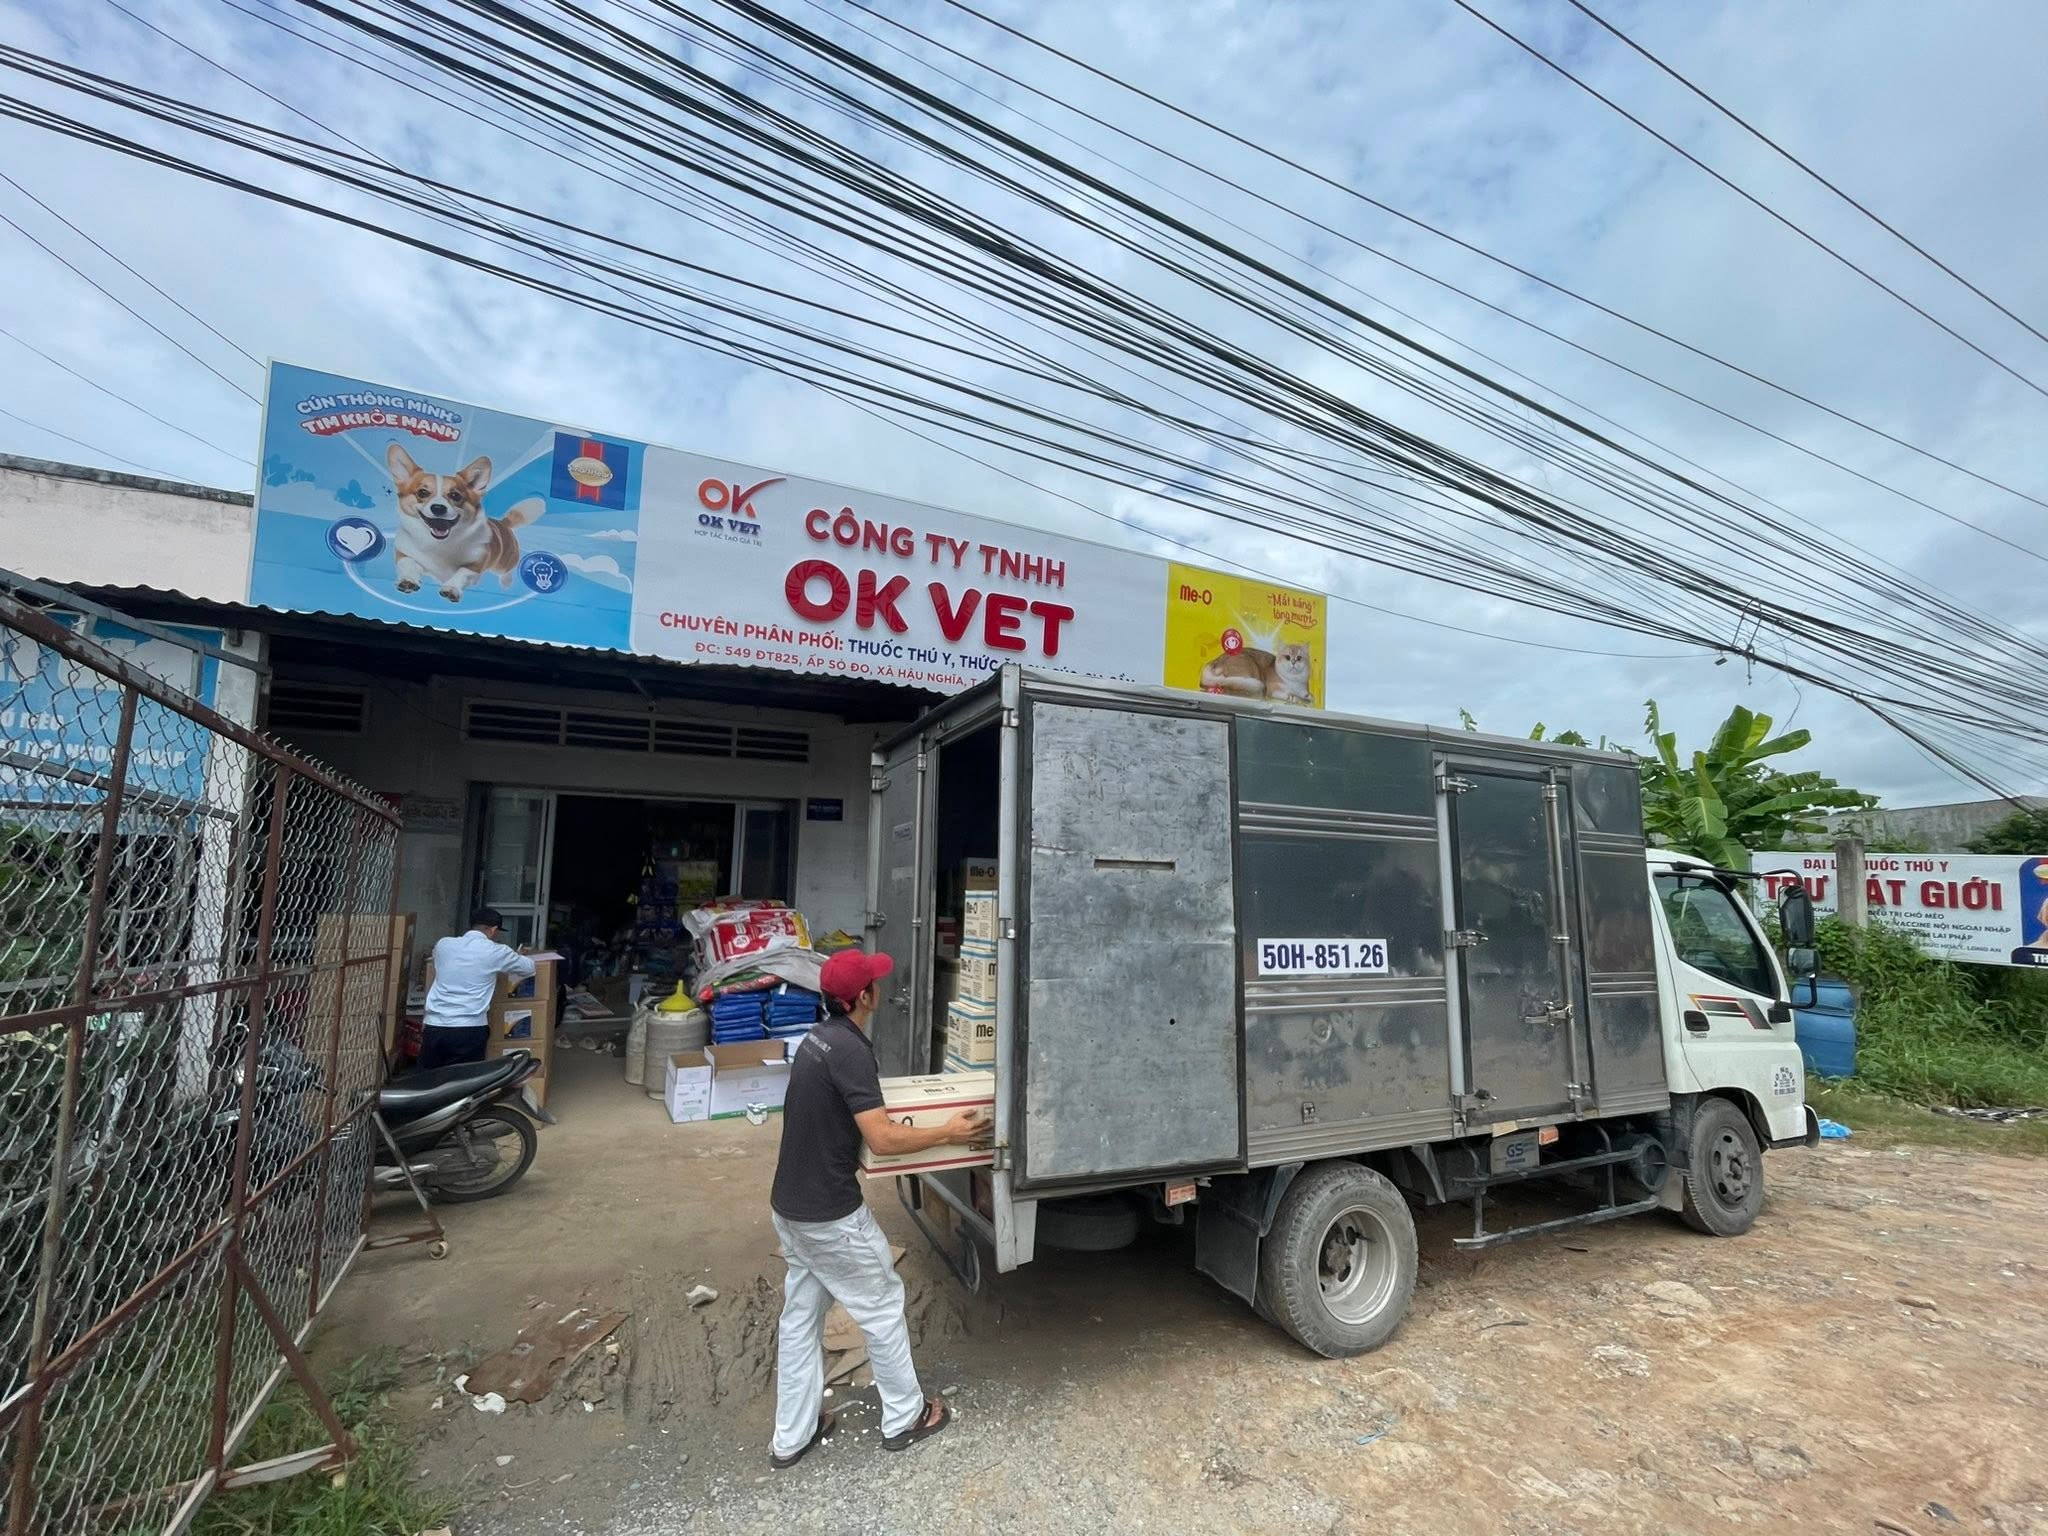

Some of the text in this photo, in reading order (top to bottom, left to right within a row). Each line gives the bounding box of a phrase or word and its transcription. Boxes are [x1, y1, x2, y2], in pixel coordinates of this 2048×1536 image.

[297, 391, 454, 422] CÚN THÔNG MINH
[302, 415, 340, 433] TIM
[401, 415, 461, 440] MẠNH
[697, 477, 787, 518] OK
[698, 513, 761, 536] OK VET
[805, 506, 1066, 588] CÔNG TY TNHH
[785, 559, 1075, 658] OK VET
[1180, 584, 1212, 605] Me-O
[660, 612, 738, 637] CHUYÊN
[744, 623, 793, 644] PHÂN
[798, 630, 844, 650] PHỐI:
[848, 639, 903, 659] THUỐC
[908, 647, 938, 663] THÚ
[941, 652, 955, 668] Y,
[960, 654, 999, 672] THỨC
[695, 642, 720, 655] ĐC:
[725, 646, 751, 658] 549
[756, 650, 802, 666] ĐT825,
[806, 653, 824, 667] ẤP
[898, 668, 923, 682] HẬU
[1804, 859, 1826, 871] ĐẠI
[1865, 857, 1899, 871] UỐC
[1904, 859, 1933, 872] THÚ
[1939, 861, 1949, 872] Y
[1866, 873, 1906, 906] ÁT
[1920, 874, 2003, 911] GIỚI
[1263, 944, 1384, 970] 50H-851.26
[976, 1023, 994, 1038] Me
